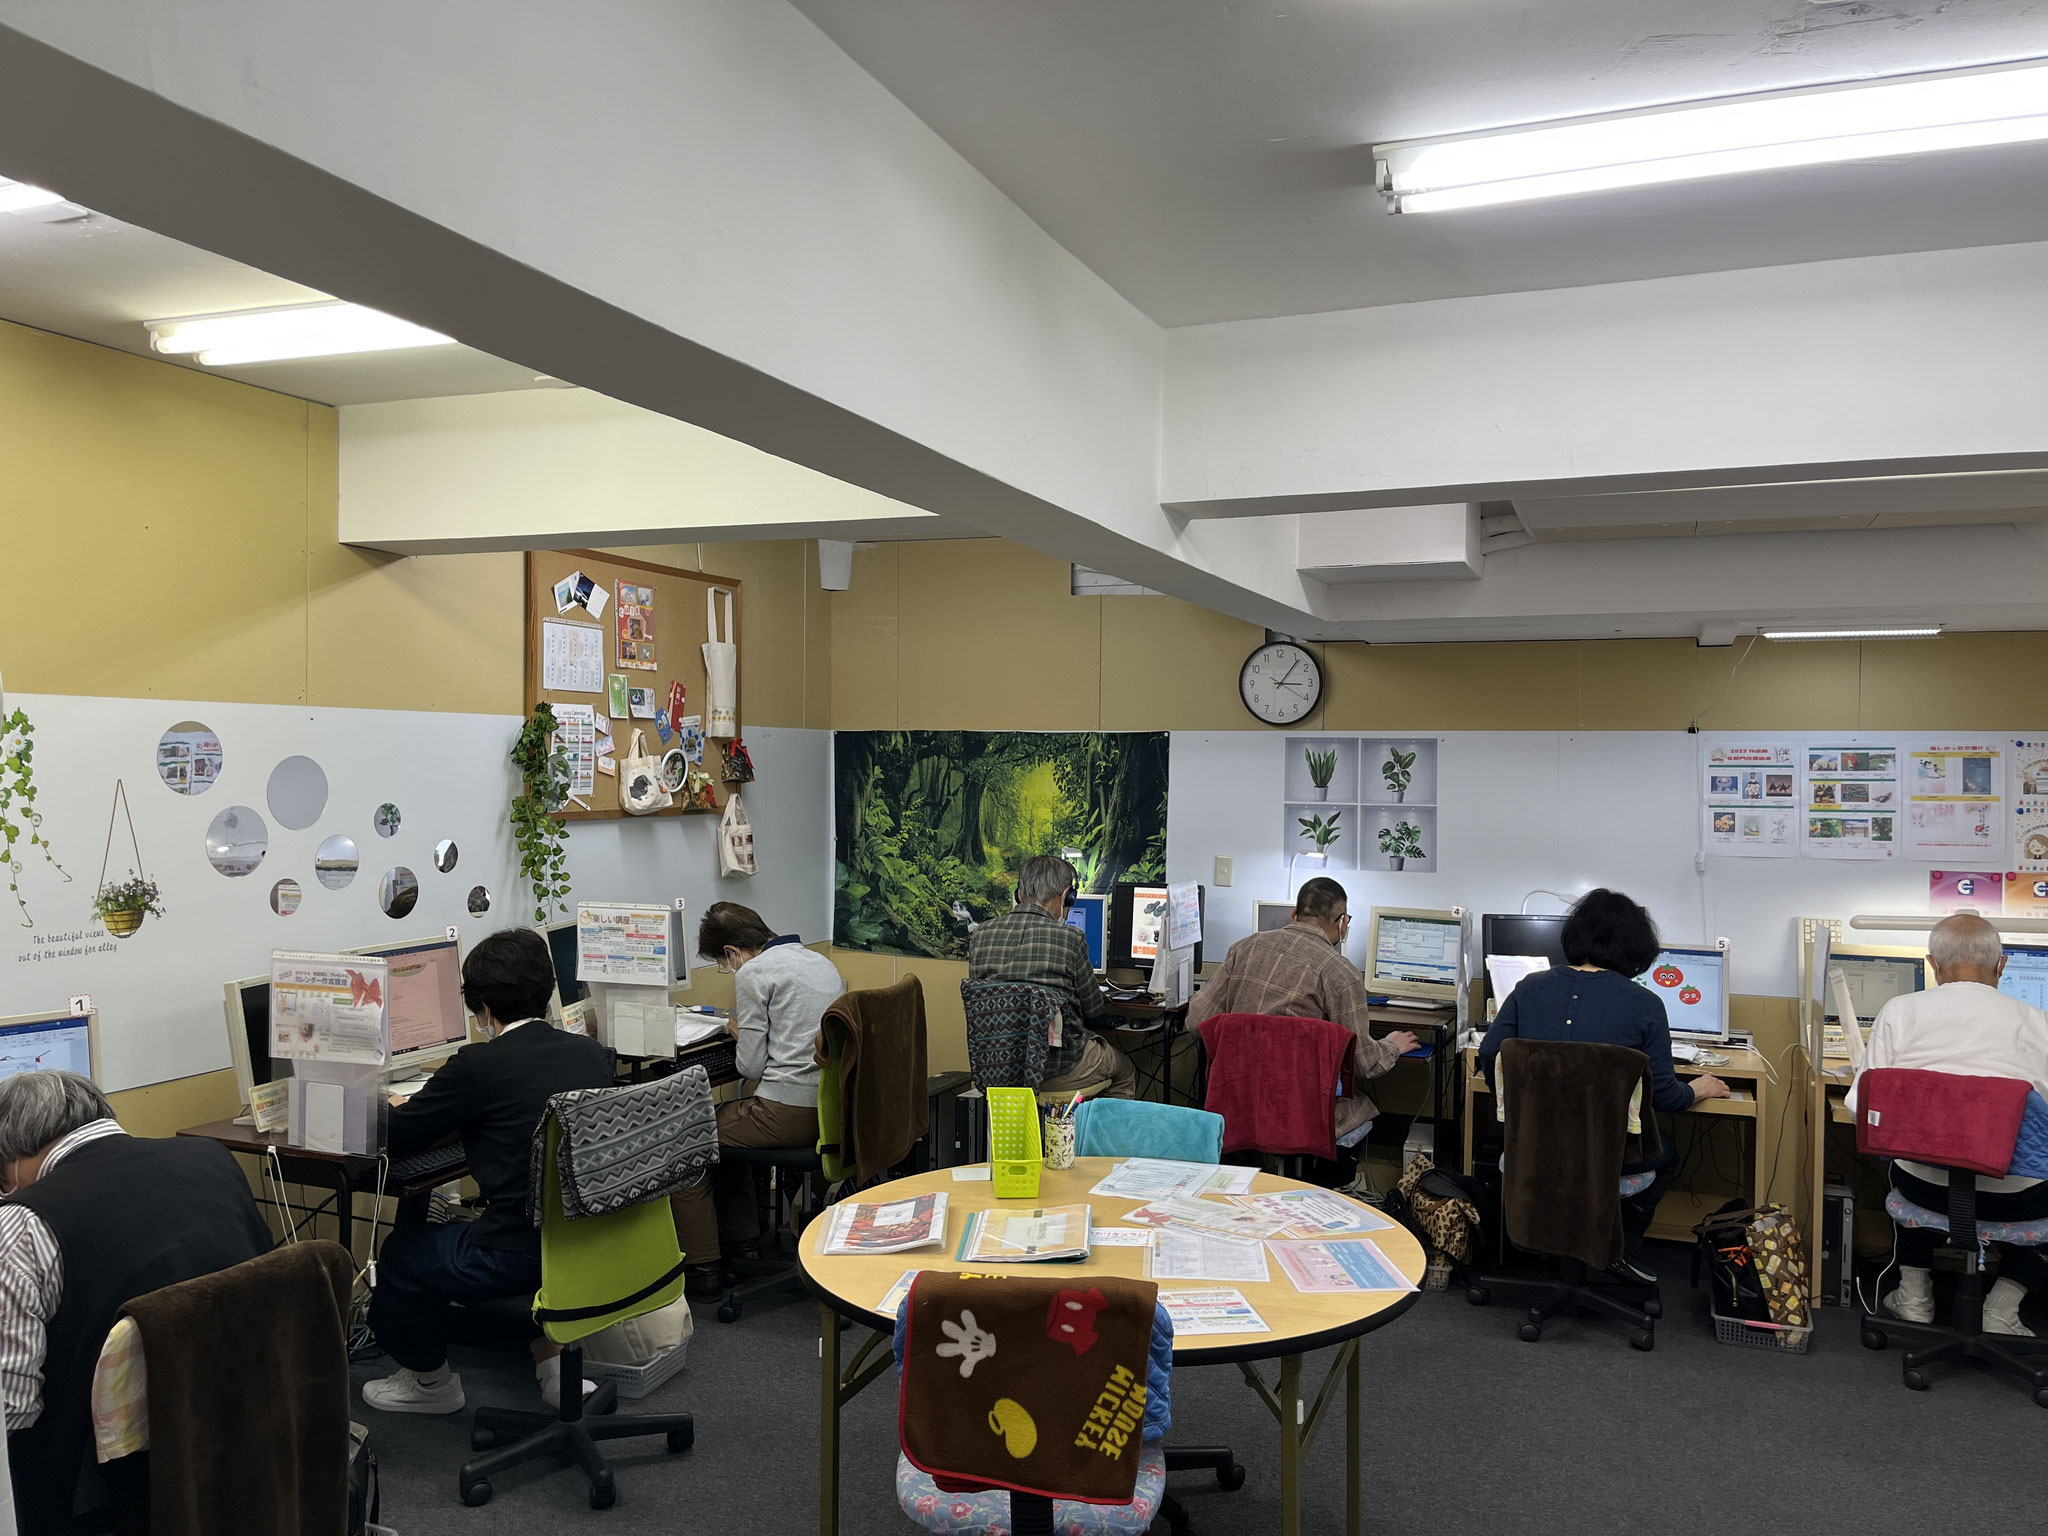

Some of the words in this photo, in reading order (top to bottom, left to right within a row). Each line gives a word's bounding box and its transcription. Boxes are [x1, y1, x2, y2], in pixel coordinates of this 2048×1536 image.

[1276, 650, 1284, 658] 12
[1252, 665, 1260, 673] 10
[1304, 664, 1308, 672] 2
[1250, 680, 1255, 688] 9
[1308, 678, 1313, 687] 3
[1254, 694, 1259, 703] 8
[1265, 705, 1269, 713] 7
[1279, 708, 1284, 717] 6
[1293, 704, 1298, 713] 5
[678, 900, 683, 908] 3
[592, 914, 630, 924] 楽しい講座
[33, 935, 44, 944] The
[48, 930, 82, 942] beautiful
[86, 930, 104, 938] views
[449, 928, 456, 938] 2
[1718, 940, 1725, 948] 5
[18, 953, 30, 962] out
[33, 950, 41, 962] of
[44, 949, 56, 958] the
[58, 946, 82, 956] window
[84, 945, 96, 956] for
[98, 942, 118, 952] alley
[294, 976, 348, 986] カレンダー作成講座
[76, 999, 83, 1011] 1
